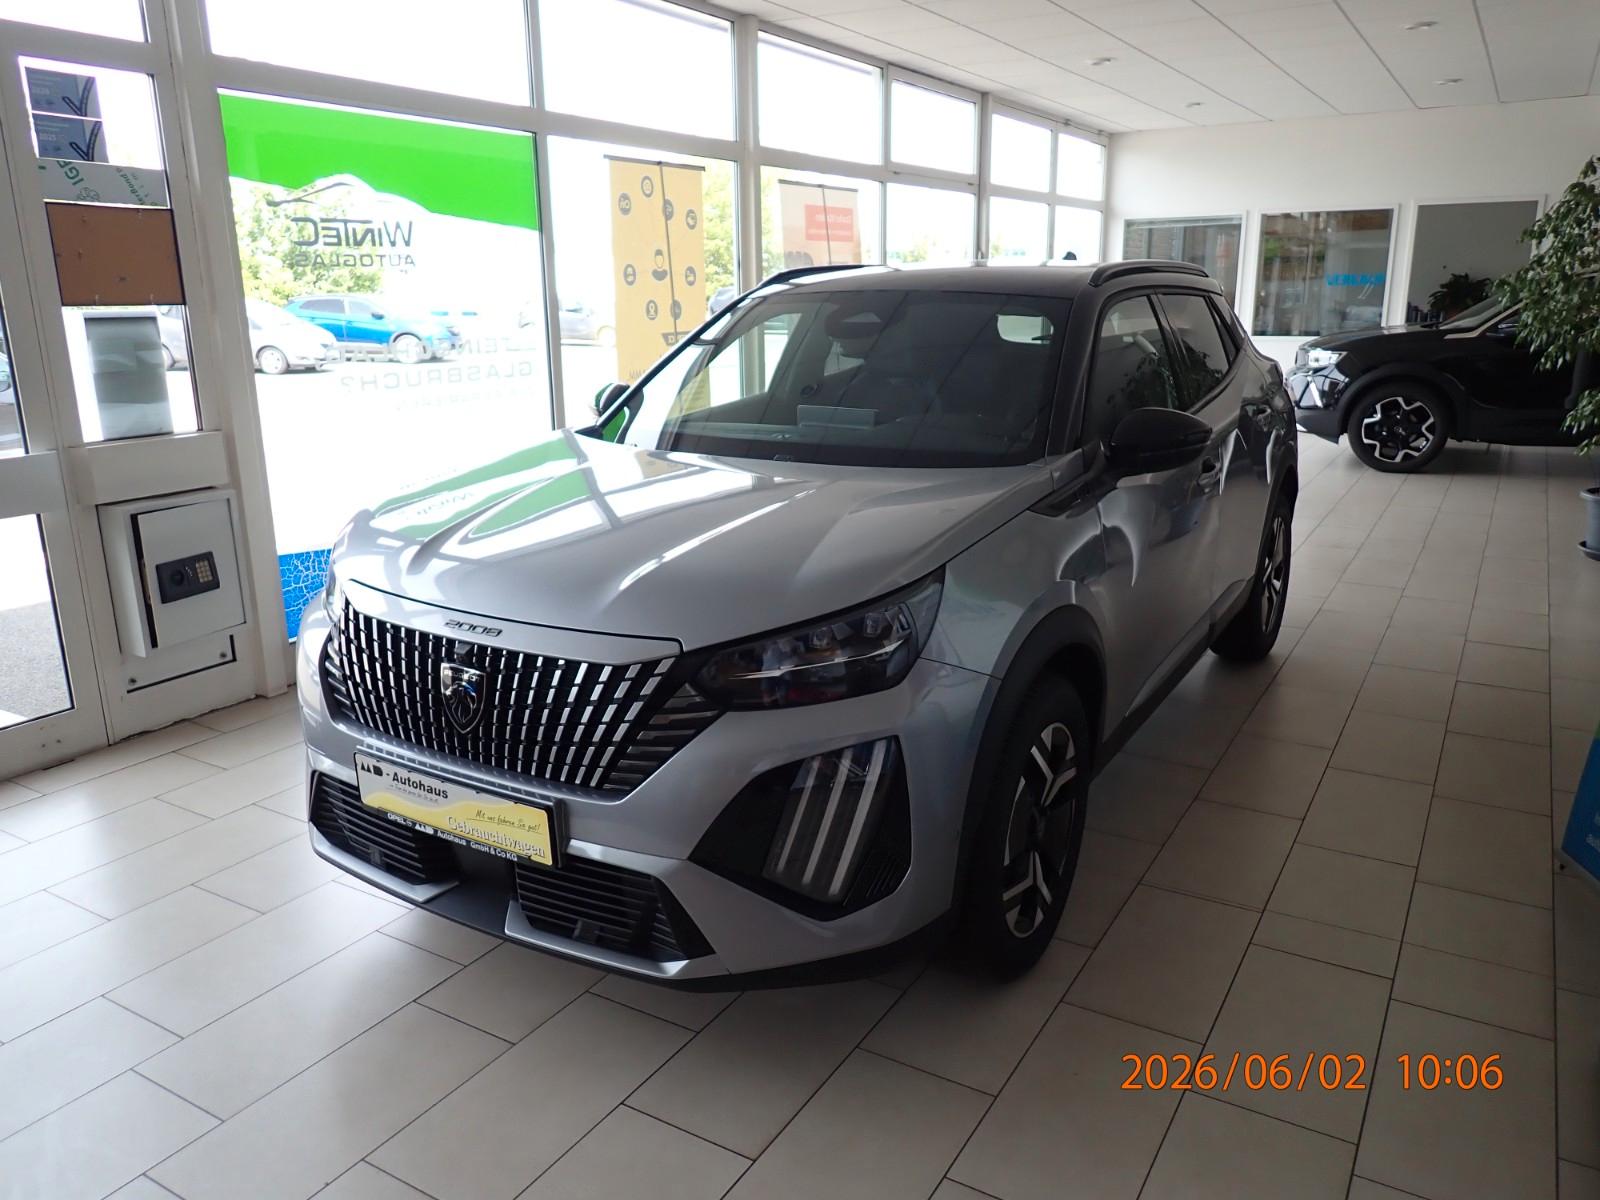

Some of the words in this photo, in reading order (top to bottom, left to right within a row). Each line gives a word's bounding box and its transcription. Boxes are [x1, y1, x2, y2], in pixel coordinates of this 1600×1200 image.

[445, 619, 503, 637] 2008
[392, 772, 449, 799] Autohaus
[387, 812, 407, 826] OPEL
[437, 830, 467, 846] Autohaus
[470, 841, 490, 853] GmbH
[506, 852, 518, 862] KG
[448, 816, 545, 859] Gebrauchtwagen
